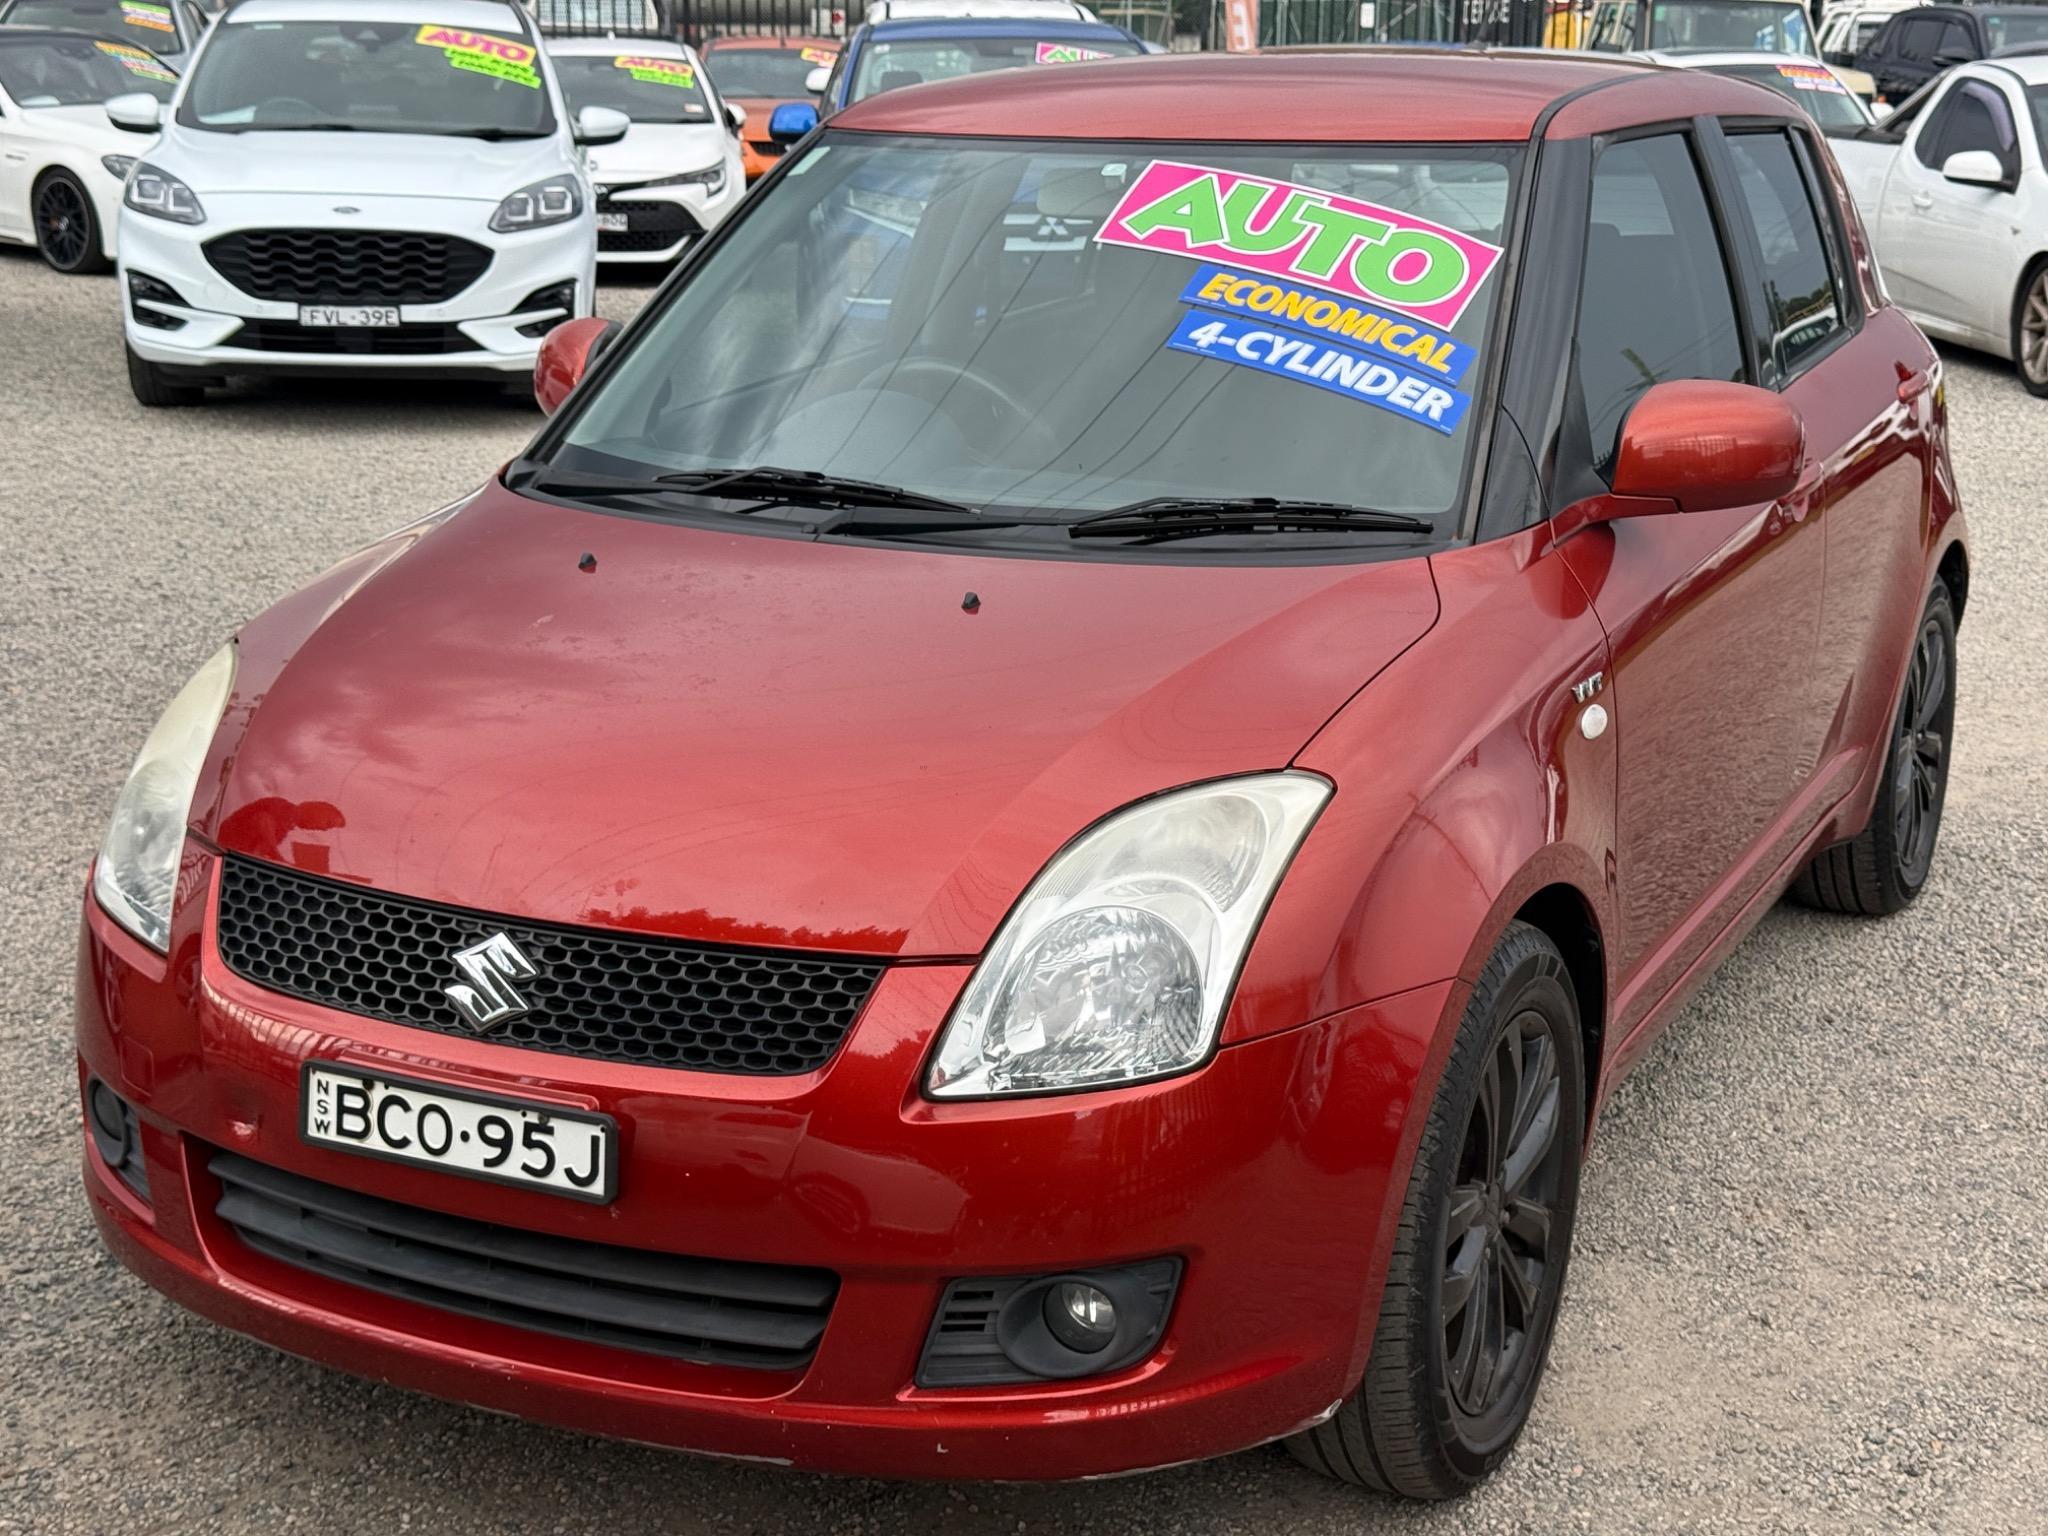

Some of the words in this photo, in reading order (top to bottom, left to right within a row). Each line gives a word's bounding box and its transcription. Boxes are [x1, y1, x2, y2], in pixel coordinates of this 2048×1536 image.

[424, 29, 528, 61] AUTO
[1117, 174, 1470, 306] AUTO
[1187, 321, 1455, 421] 4-CYLINDER
[1197, 272, 1457, 374] ECONOMICAL
[314, 1078, 331, 1135] NSW
